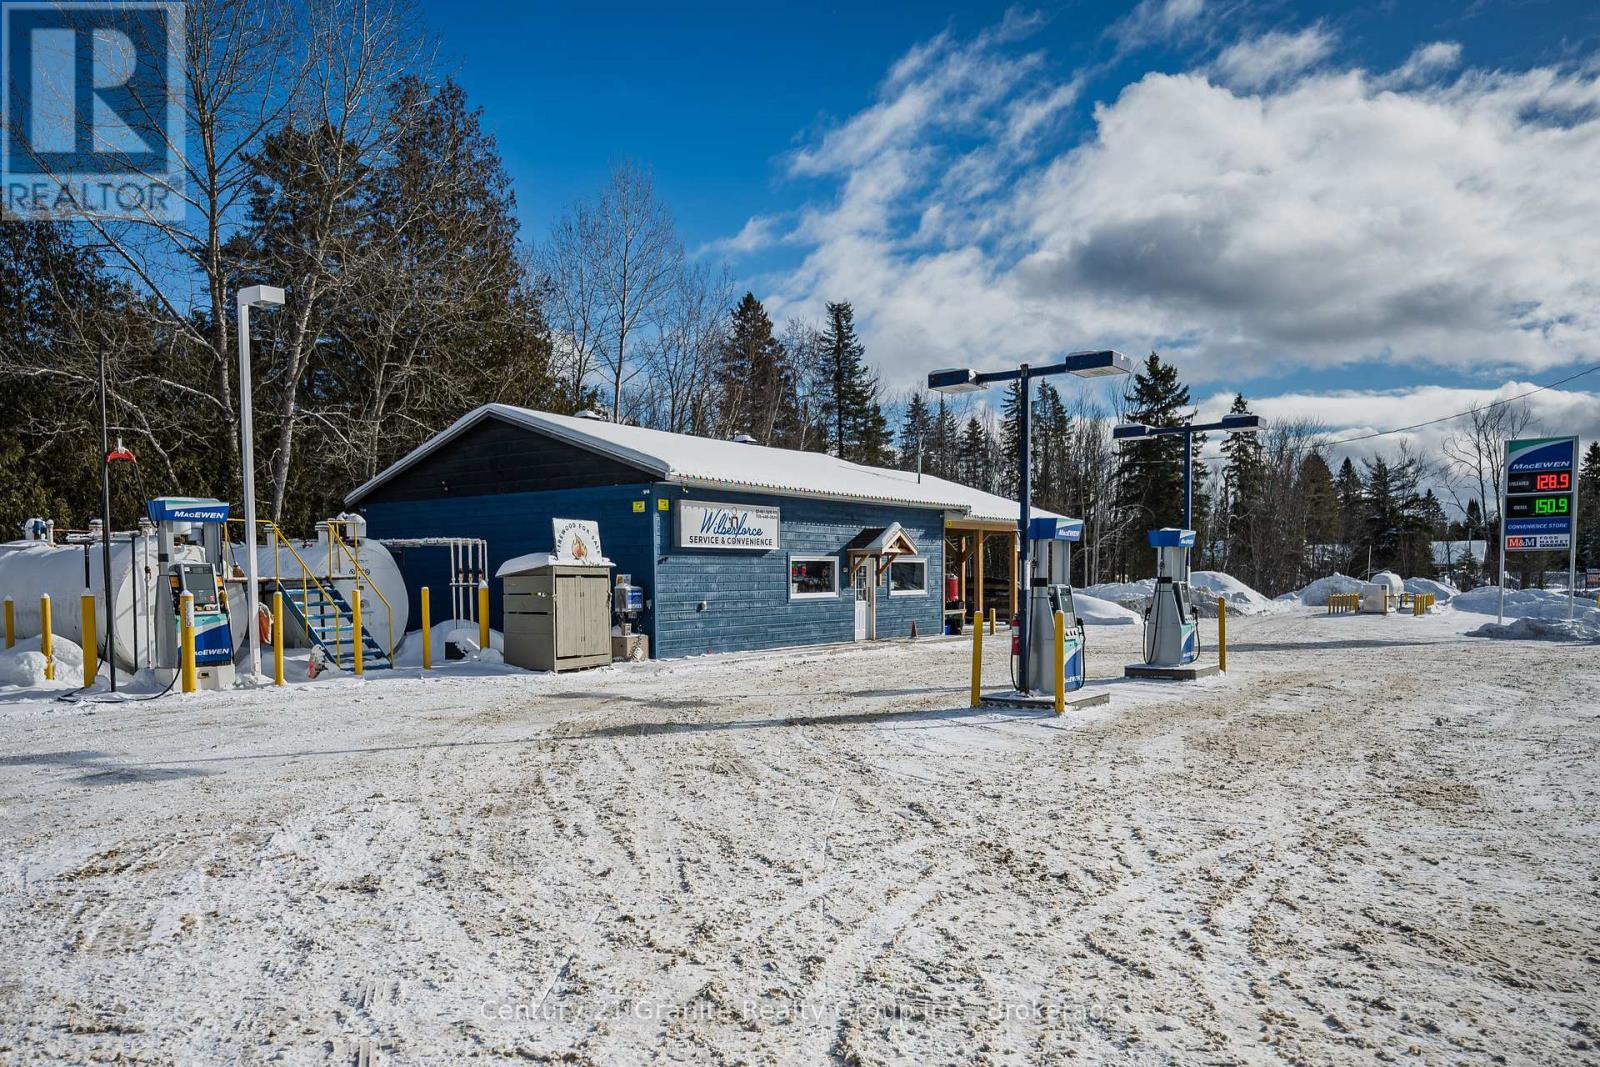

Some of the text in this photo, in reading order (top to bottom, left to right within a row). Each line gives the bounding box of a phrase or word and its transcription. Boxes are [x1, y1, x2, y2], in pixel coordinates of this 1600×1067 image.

[1537, 473, 1569, 490] 128.9
[1536, 498, 1568, 513] 150.9
[700, 508, 763, 537] Wilberforce
[556, 522, 576, 553] FIREWOOD
[578, 523, 590, 535] FOR
[689, 535, 773, 546] SERVICE & CONVENIENCE
[1508, 538, 1535, 547] M&M
